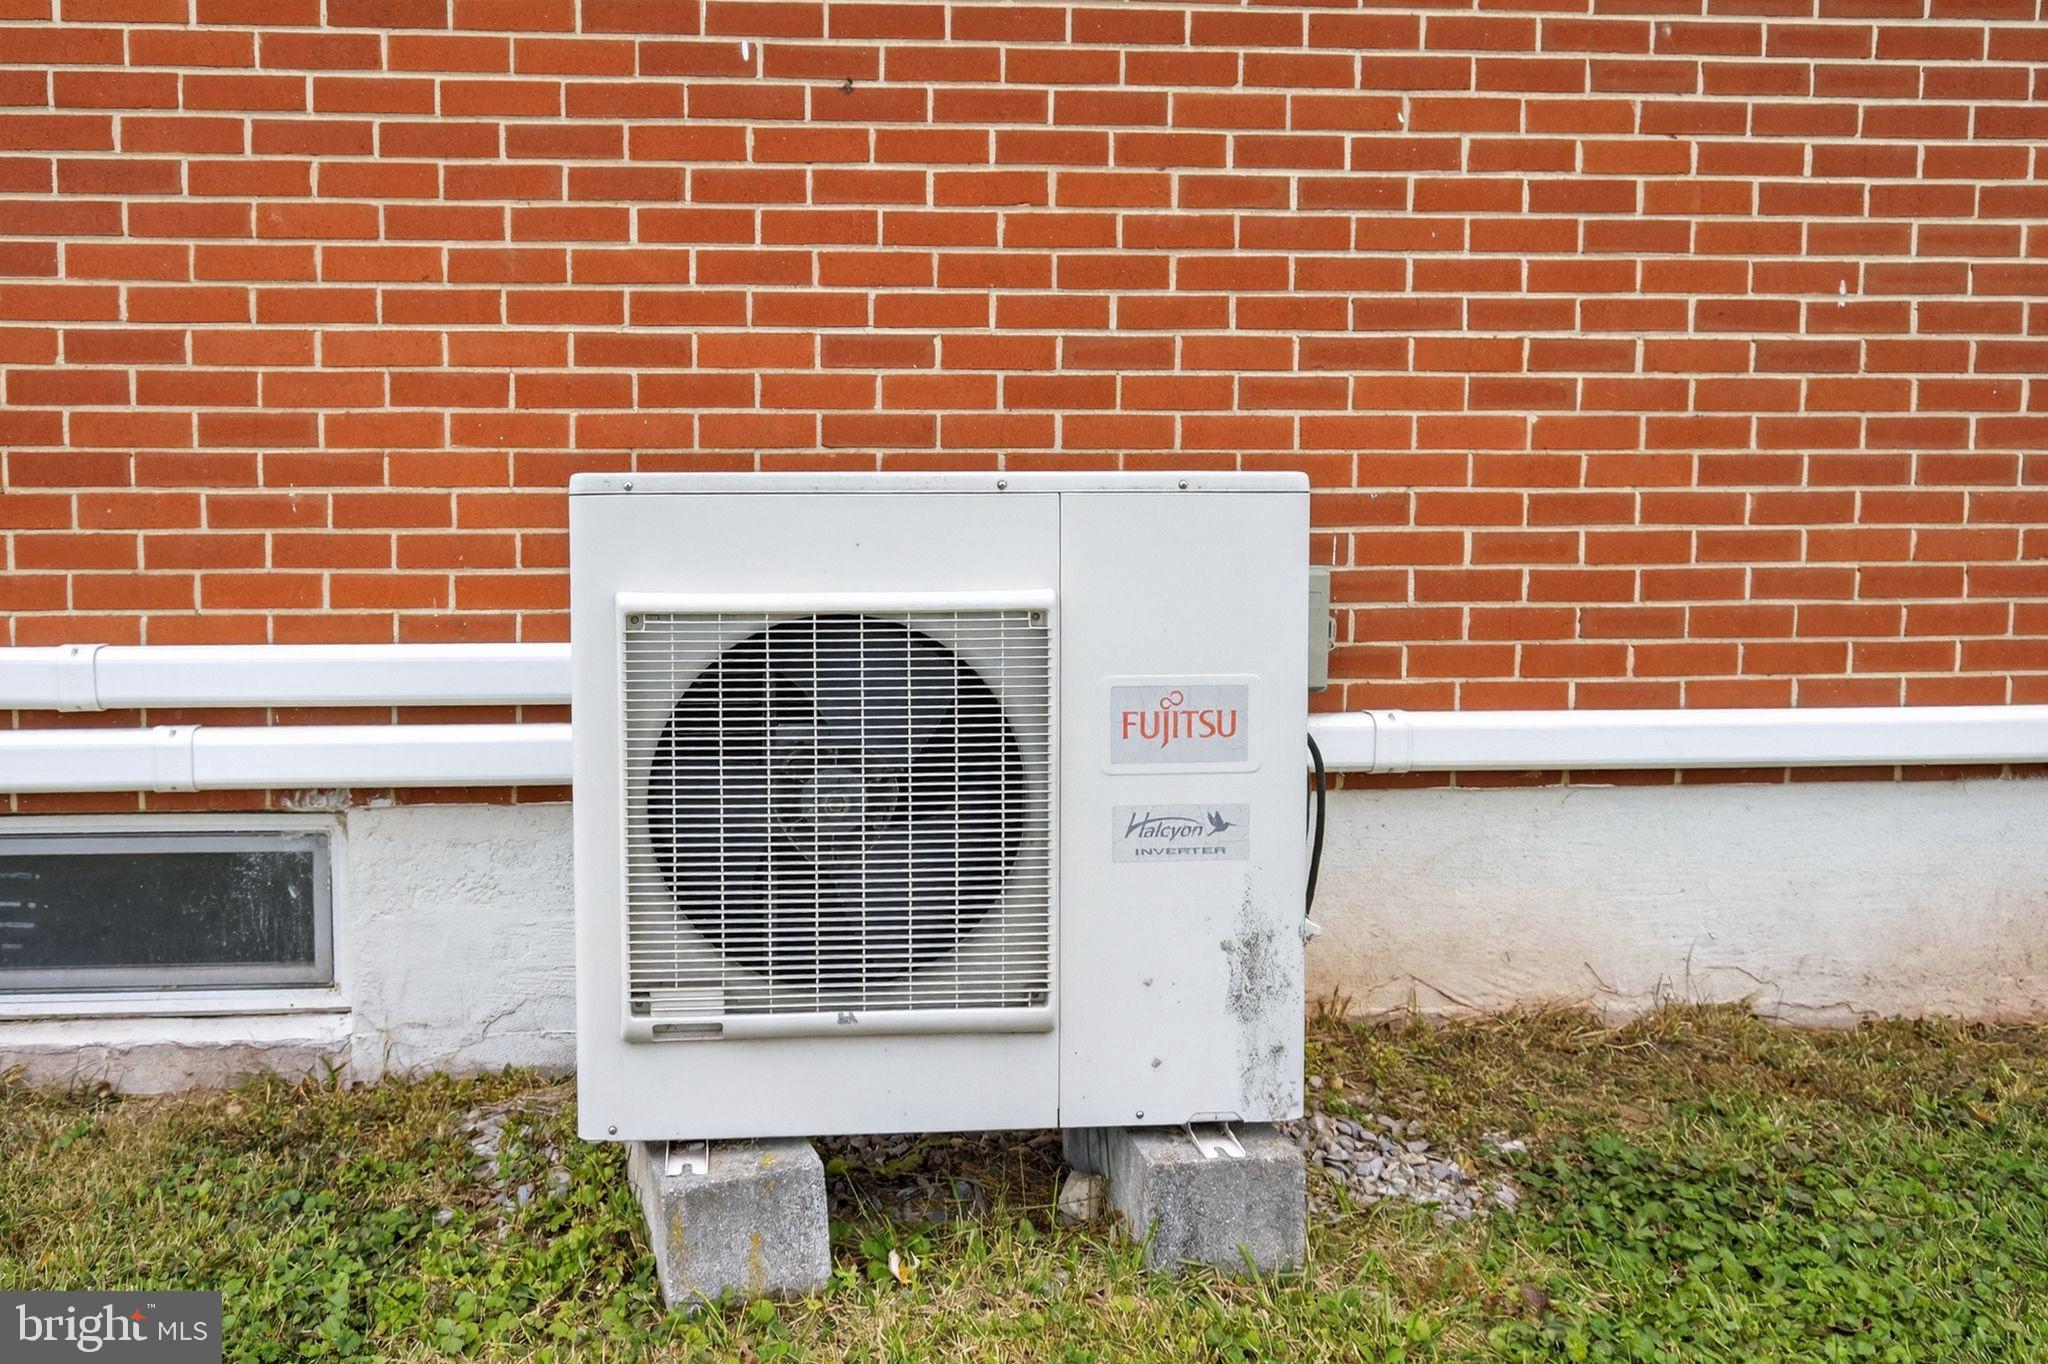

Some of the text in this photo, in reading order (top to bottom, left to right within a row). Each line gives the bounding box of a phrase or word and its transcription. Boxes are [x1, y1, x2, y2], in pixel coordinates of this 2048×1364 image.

[1122, 694, 1238, 749] FUJITSU
[1124, 811, 1203, 842] Halcyon
[1134, 846, 1227, 857] INVERTER
